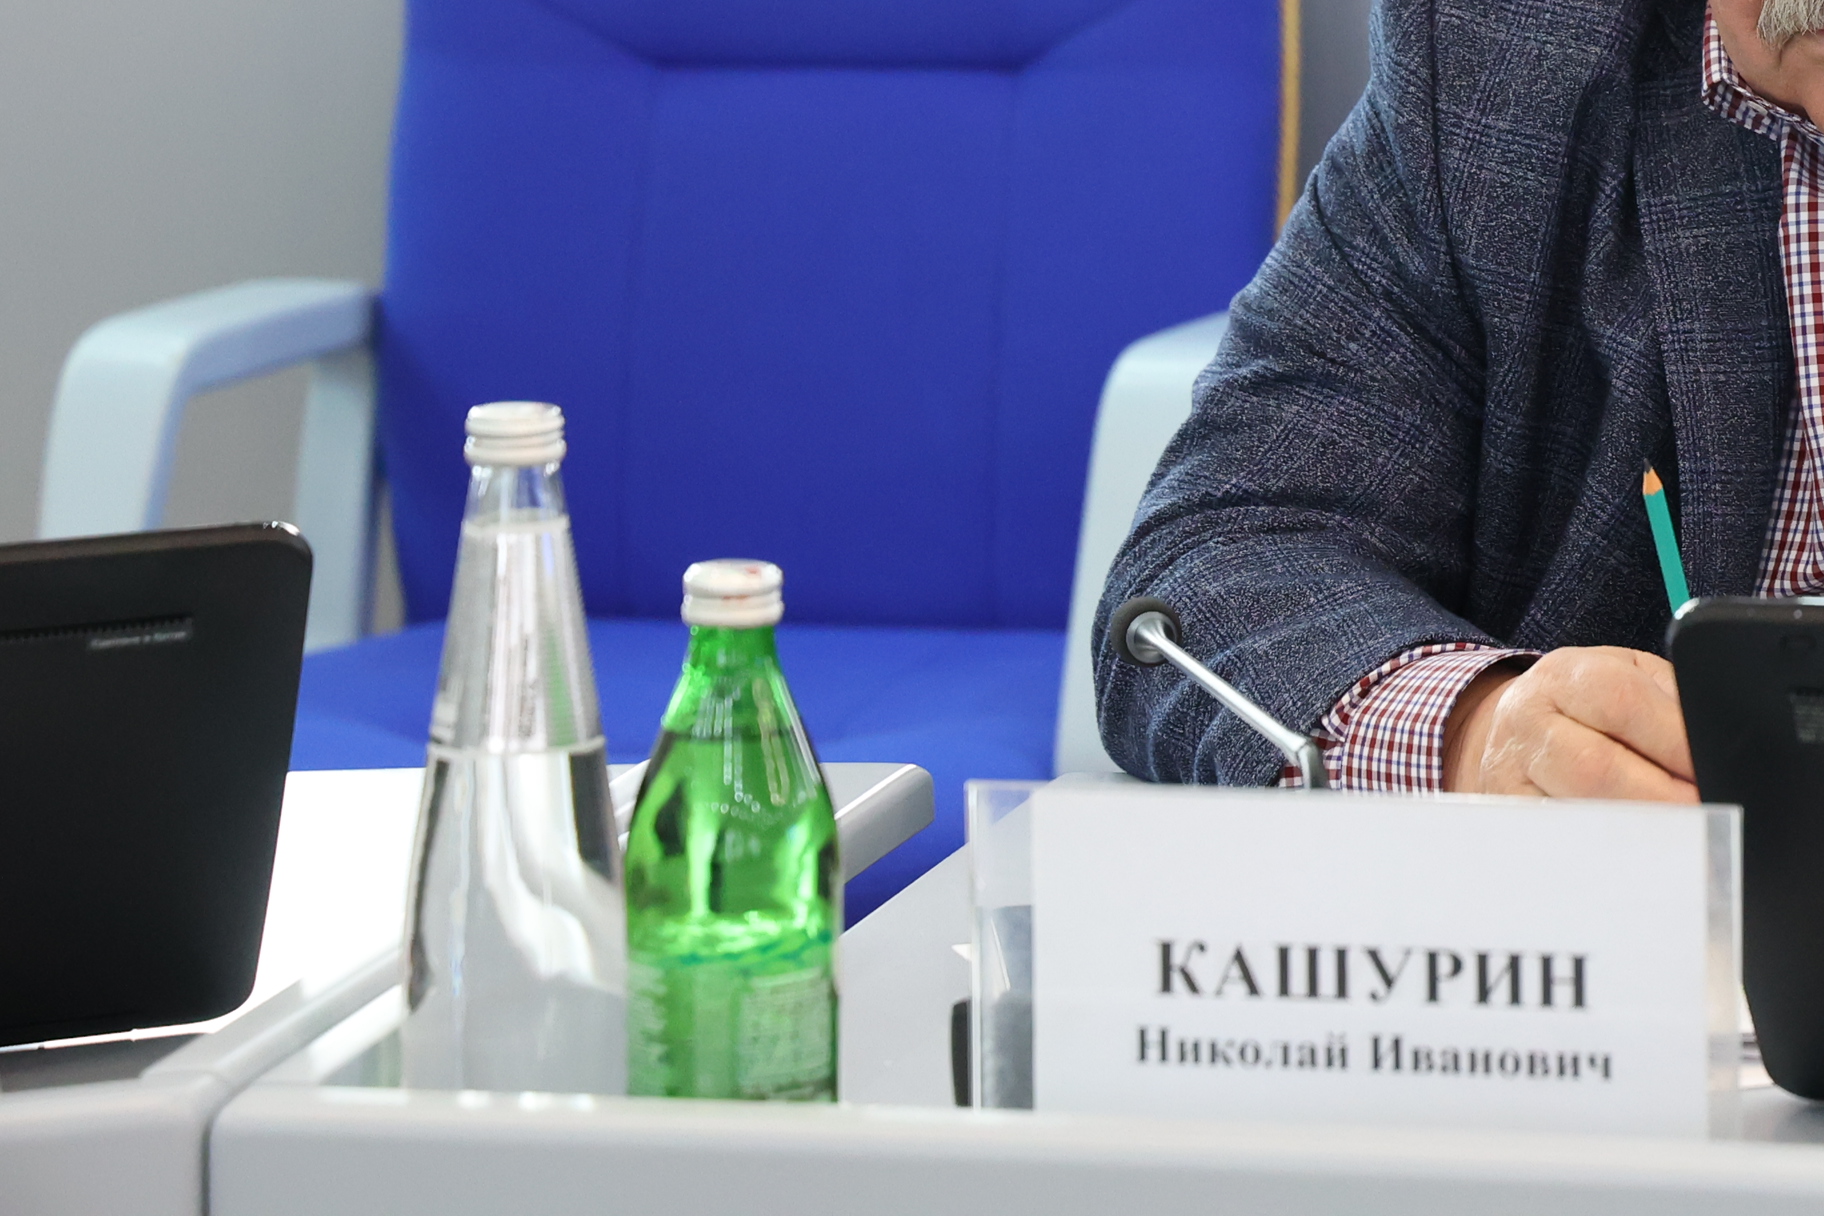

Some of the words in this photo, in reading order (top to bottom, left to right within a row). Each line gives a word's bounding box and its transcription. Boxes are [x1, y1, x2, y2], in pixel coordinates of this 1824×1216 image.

[1155, 939, 1590, 1010] КАШУРИН
[1135, 1026, 1350, 1071] Николай
[1369, 1034, 1613, 1081] Иванович
